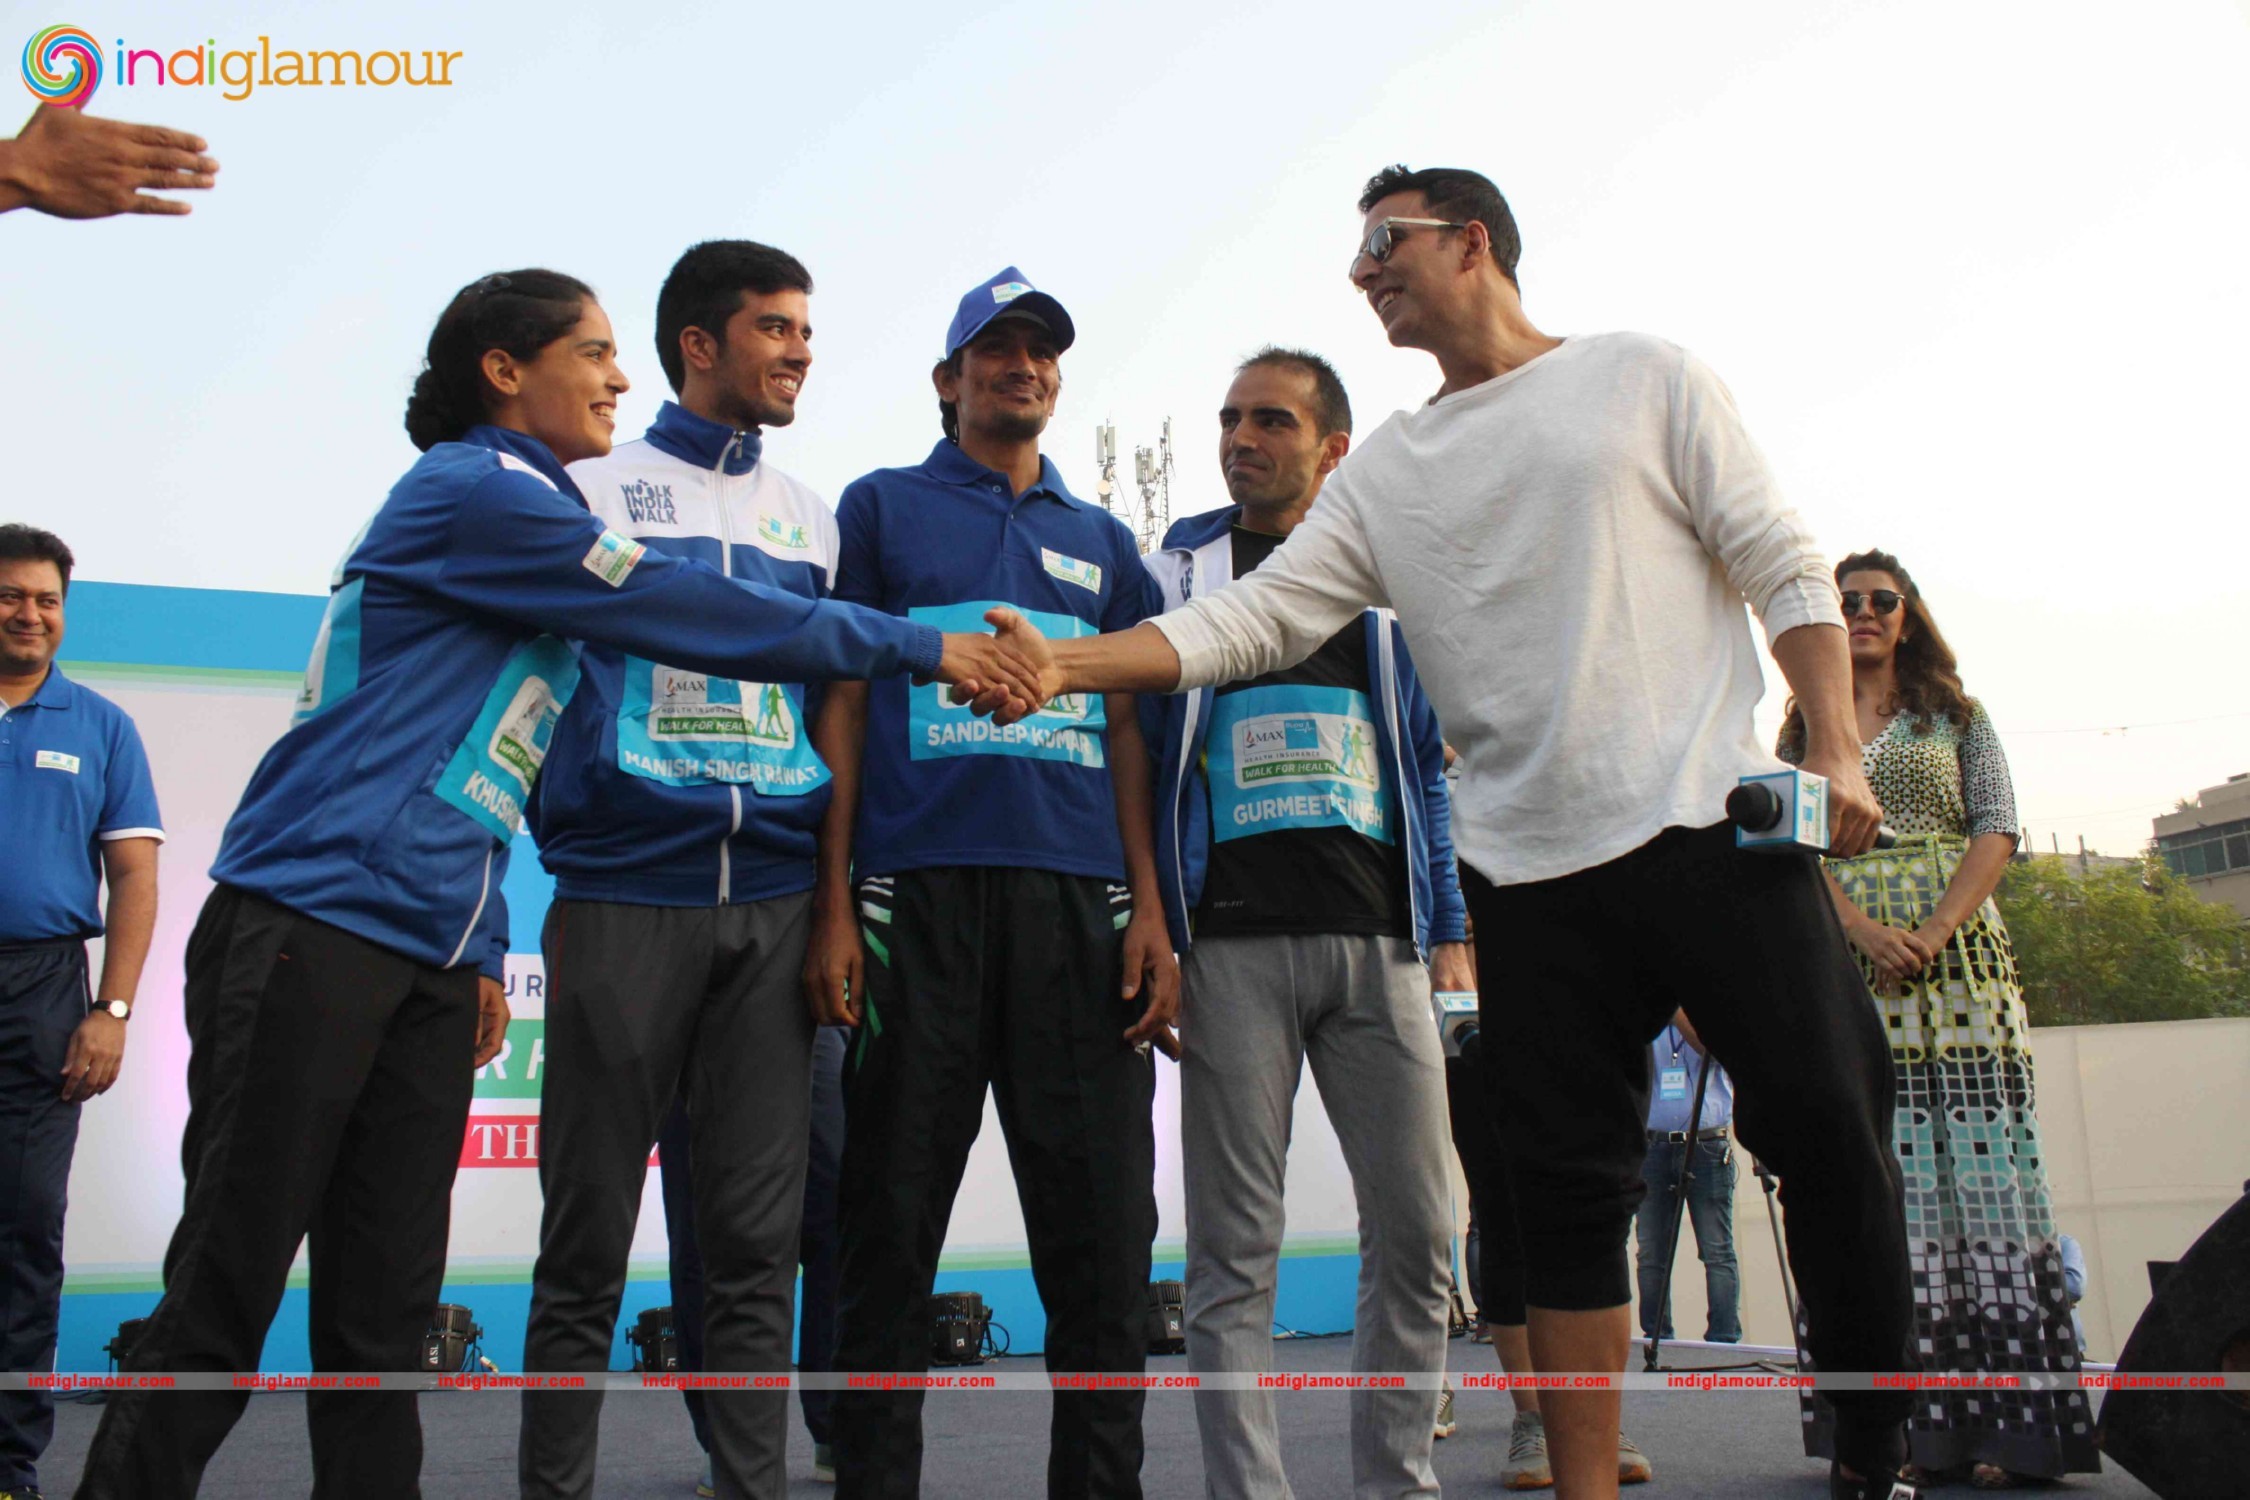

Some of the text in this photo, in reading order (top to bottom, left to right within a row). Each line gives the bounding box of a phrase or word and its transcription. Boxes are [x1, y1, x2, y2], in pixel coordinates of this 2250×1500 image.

[625, 496, 675, 510] INDIA
[628, 508, 678, 525] WALK
[675, 680, 706, 692] MAX
[660, 720, 690, 731] WALK
[692, 720, 714, 731] FOR
[927, 720, 1028, 746] SANDEEP
[1255, 730, 1284, 744] MAX
[1244, 750, 1320, 763] HEALTH INSURANCE
[624, 750, 819, 785] MANISH SINGH RAWAT
[1245, 763, 1336, 778] WALK FOR HEALTH
[1232, 794, 1332, 825] GURMEET
